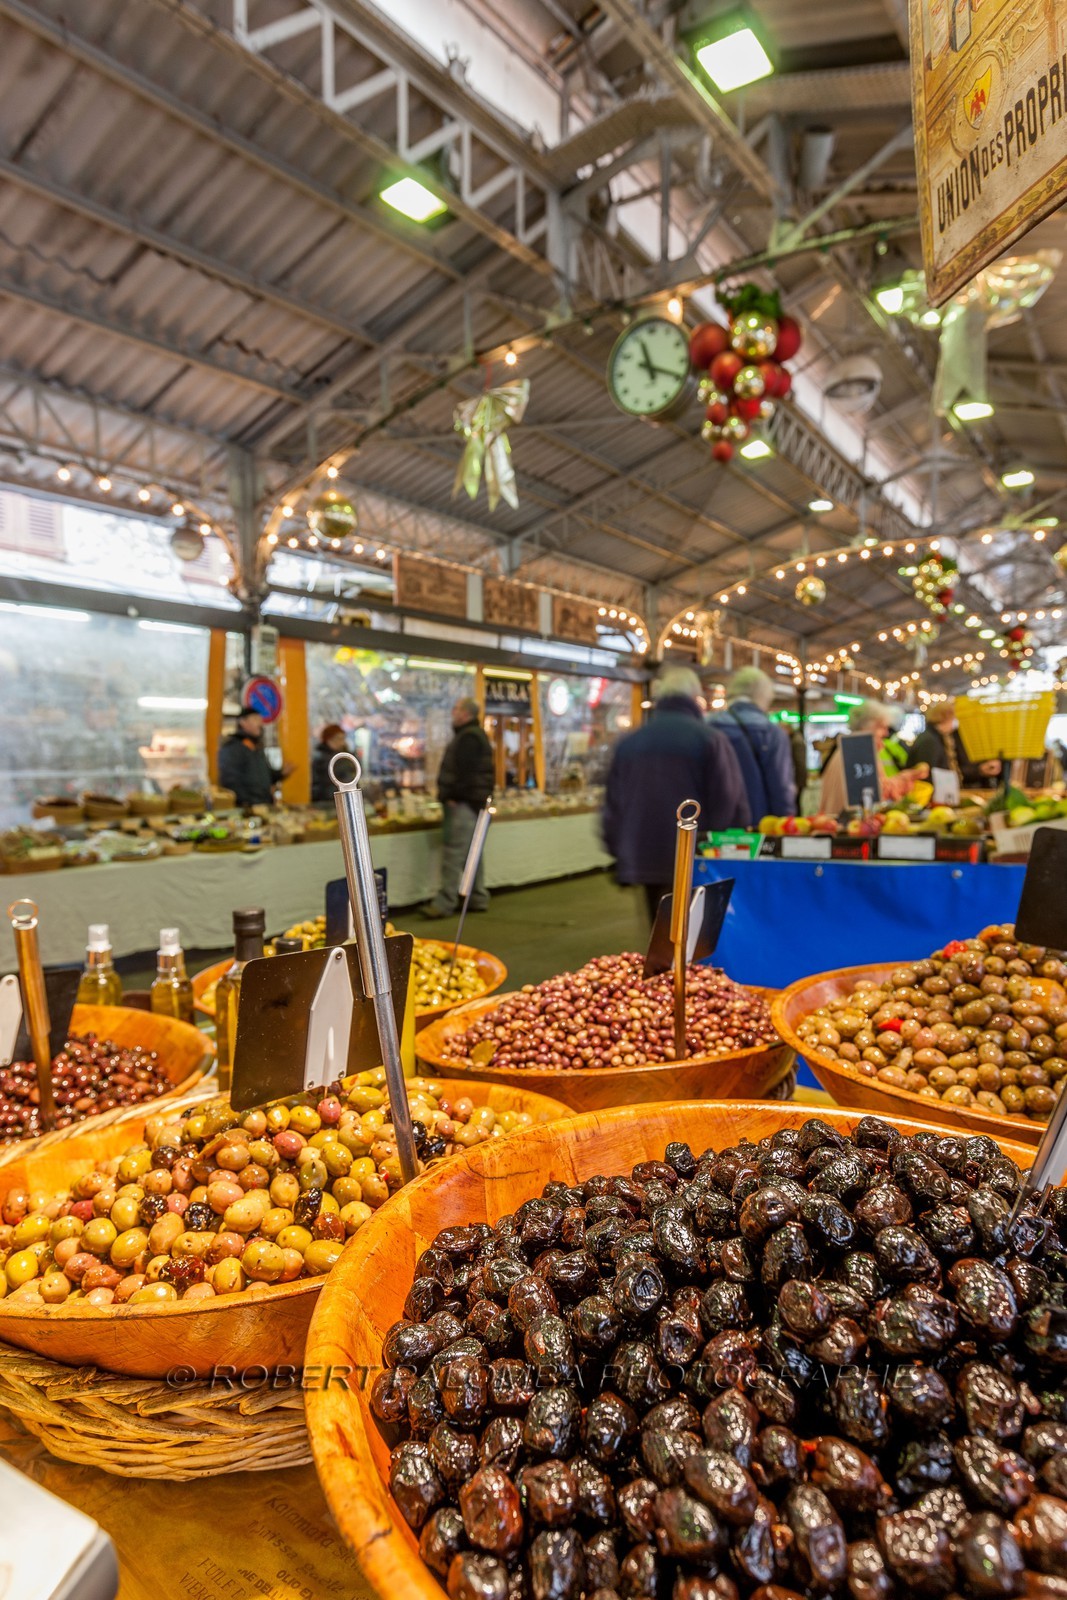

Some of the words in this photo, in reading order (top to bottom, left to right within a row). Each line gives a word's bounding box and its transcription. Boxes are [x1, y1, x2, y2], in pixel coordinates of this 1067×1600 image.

[937, 144, 981, 233] UNION
[982, 131, 1004, 178] DES
[276, 1569, 301, 1590] OLIO
